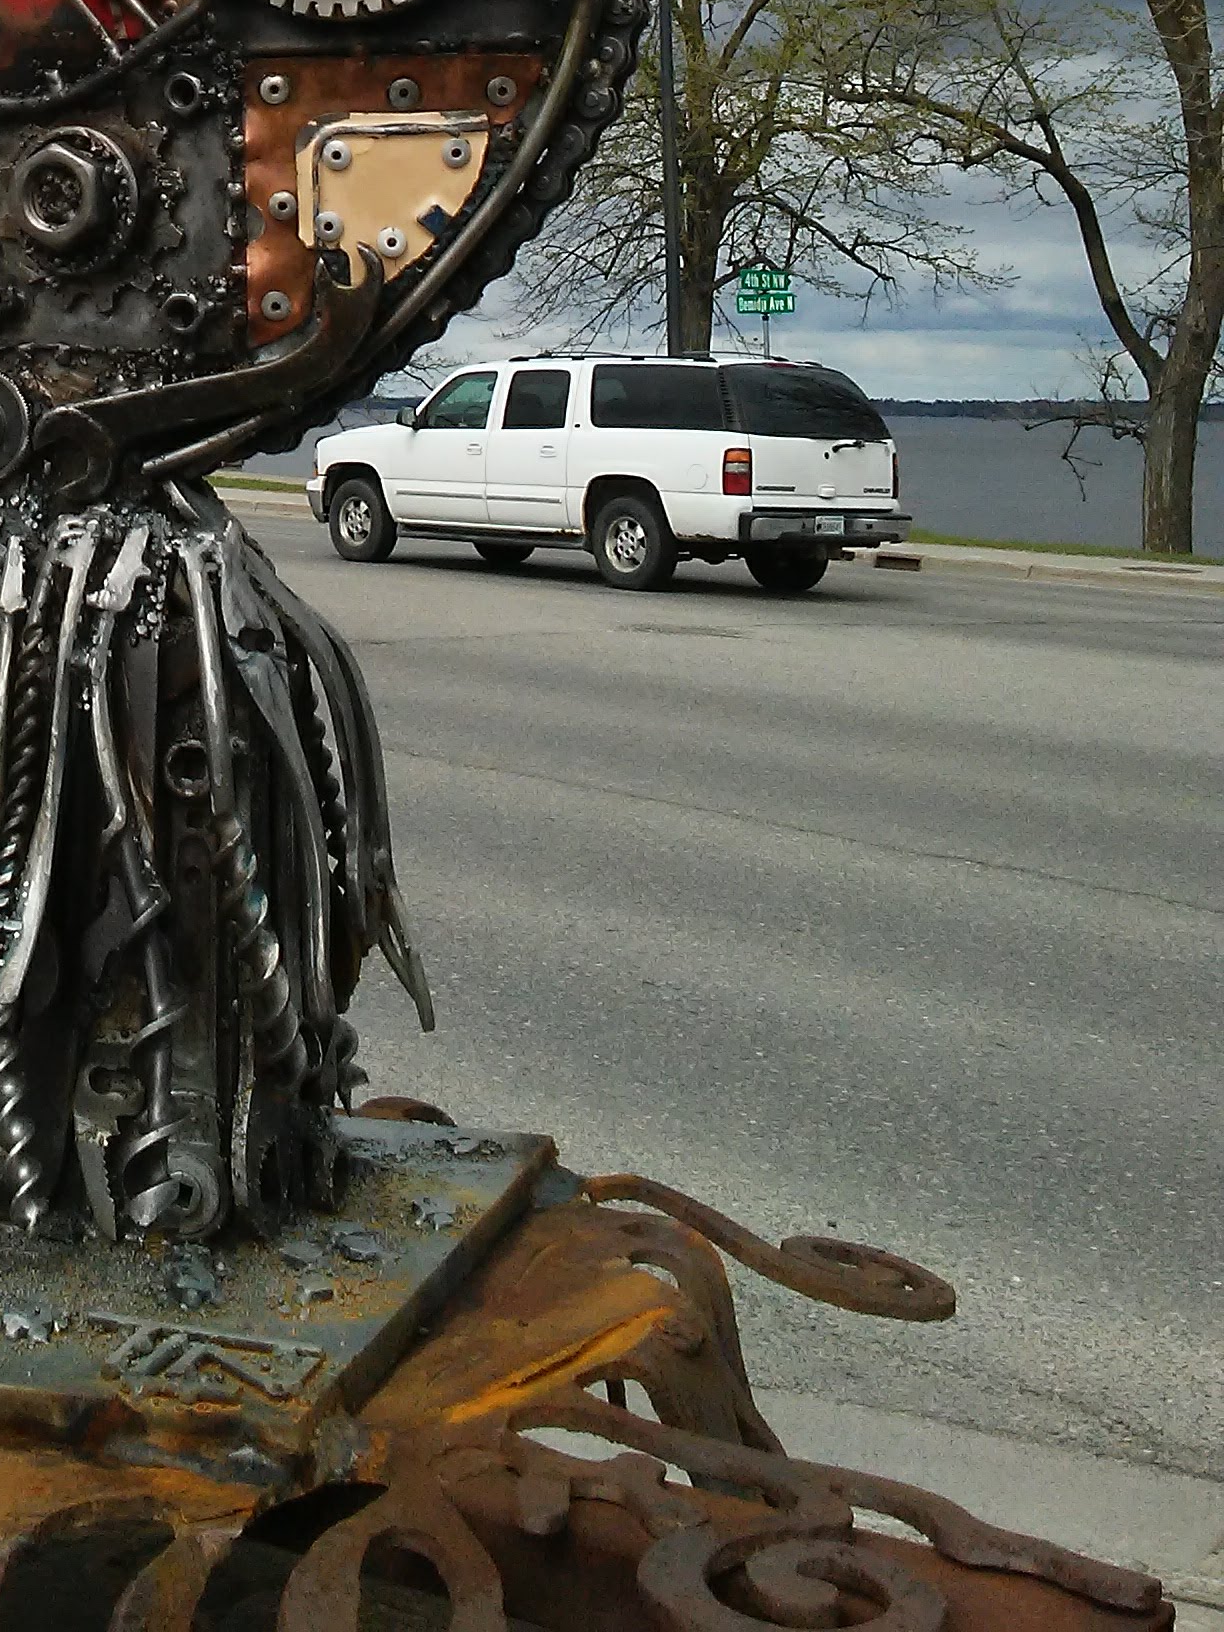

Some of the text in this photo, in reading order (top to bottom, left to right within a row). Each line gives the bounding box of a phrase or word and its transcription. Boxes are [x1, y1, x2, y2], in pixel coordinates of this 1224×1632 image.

[744, 273, 785, 288] 4th St NW
[769, 296, 784, 310] Ave
[787, 296, 793, 310] N
